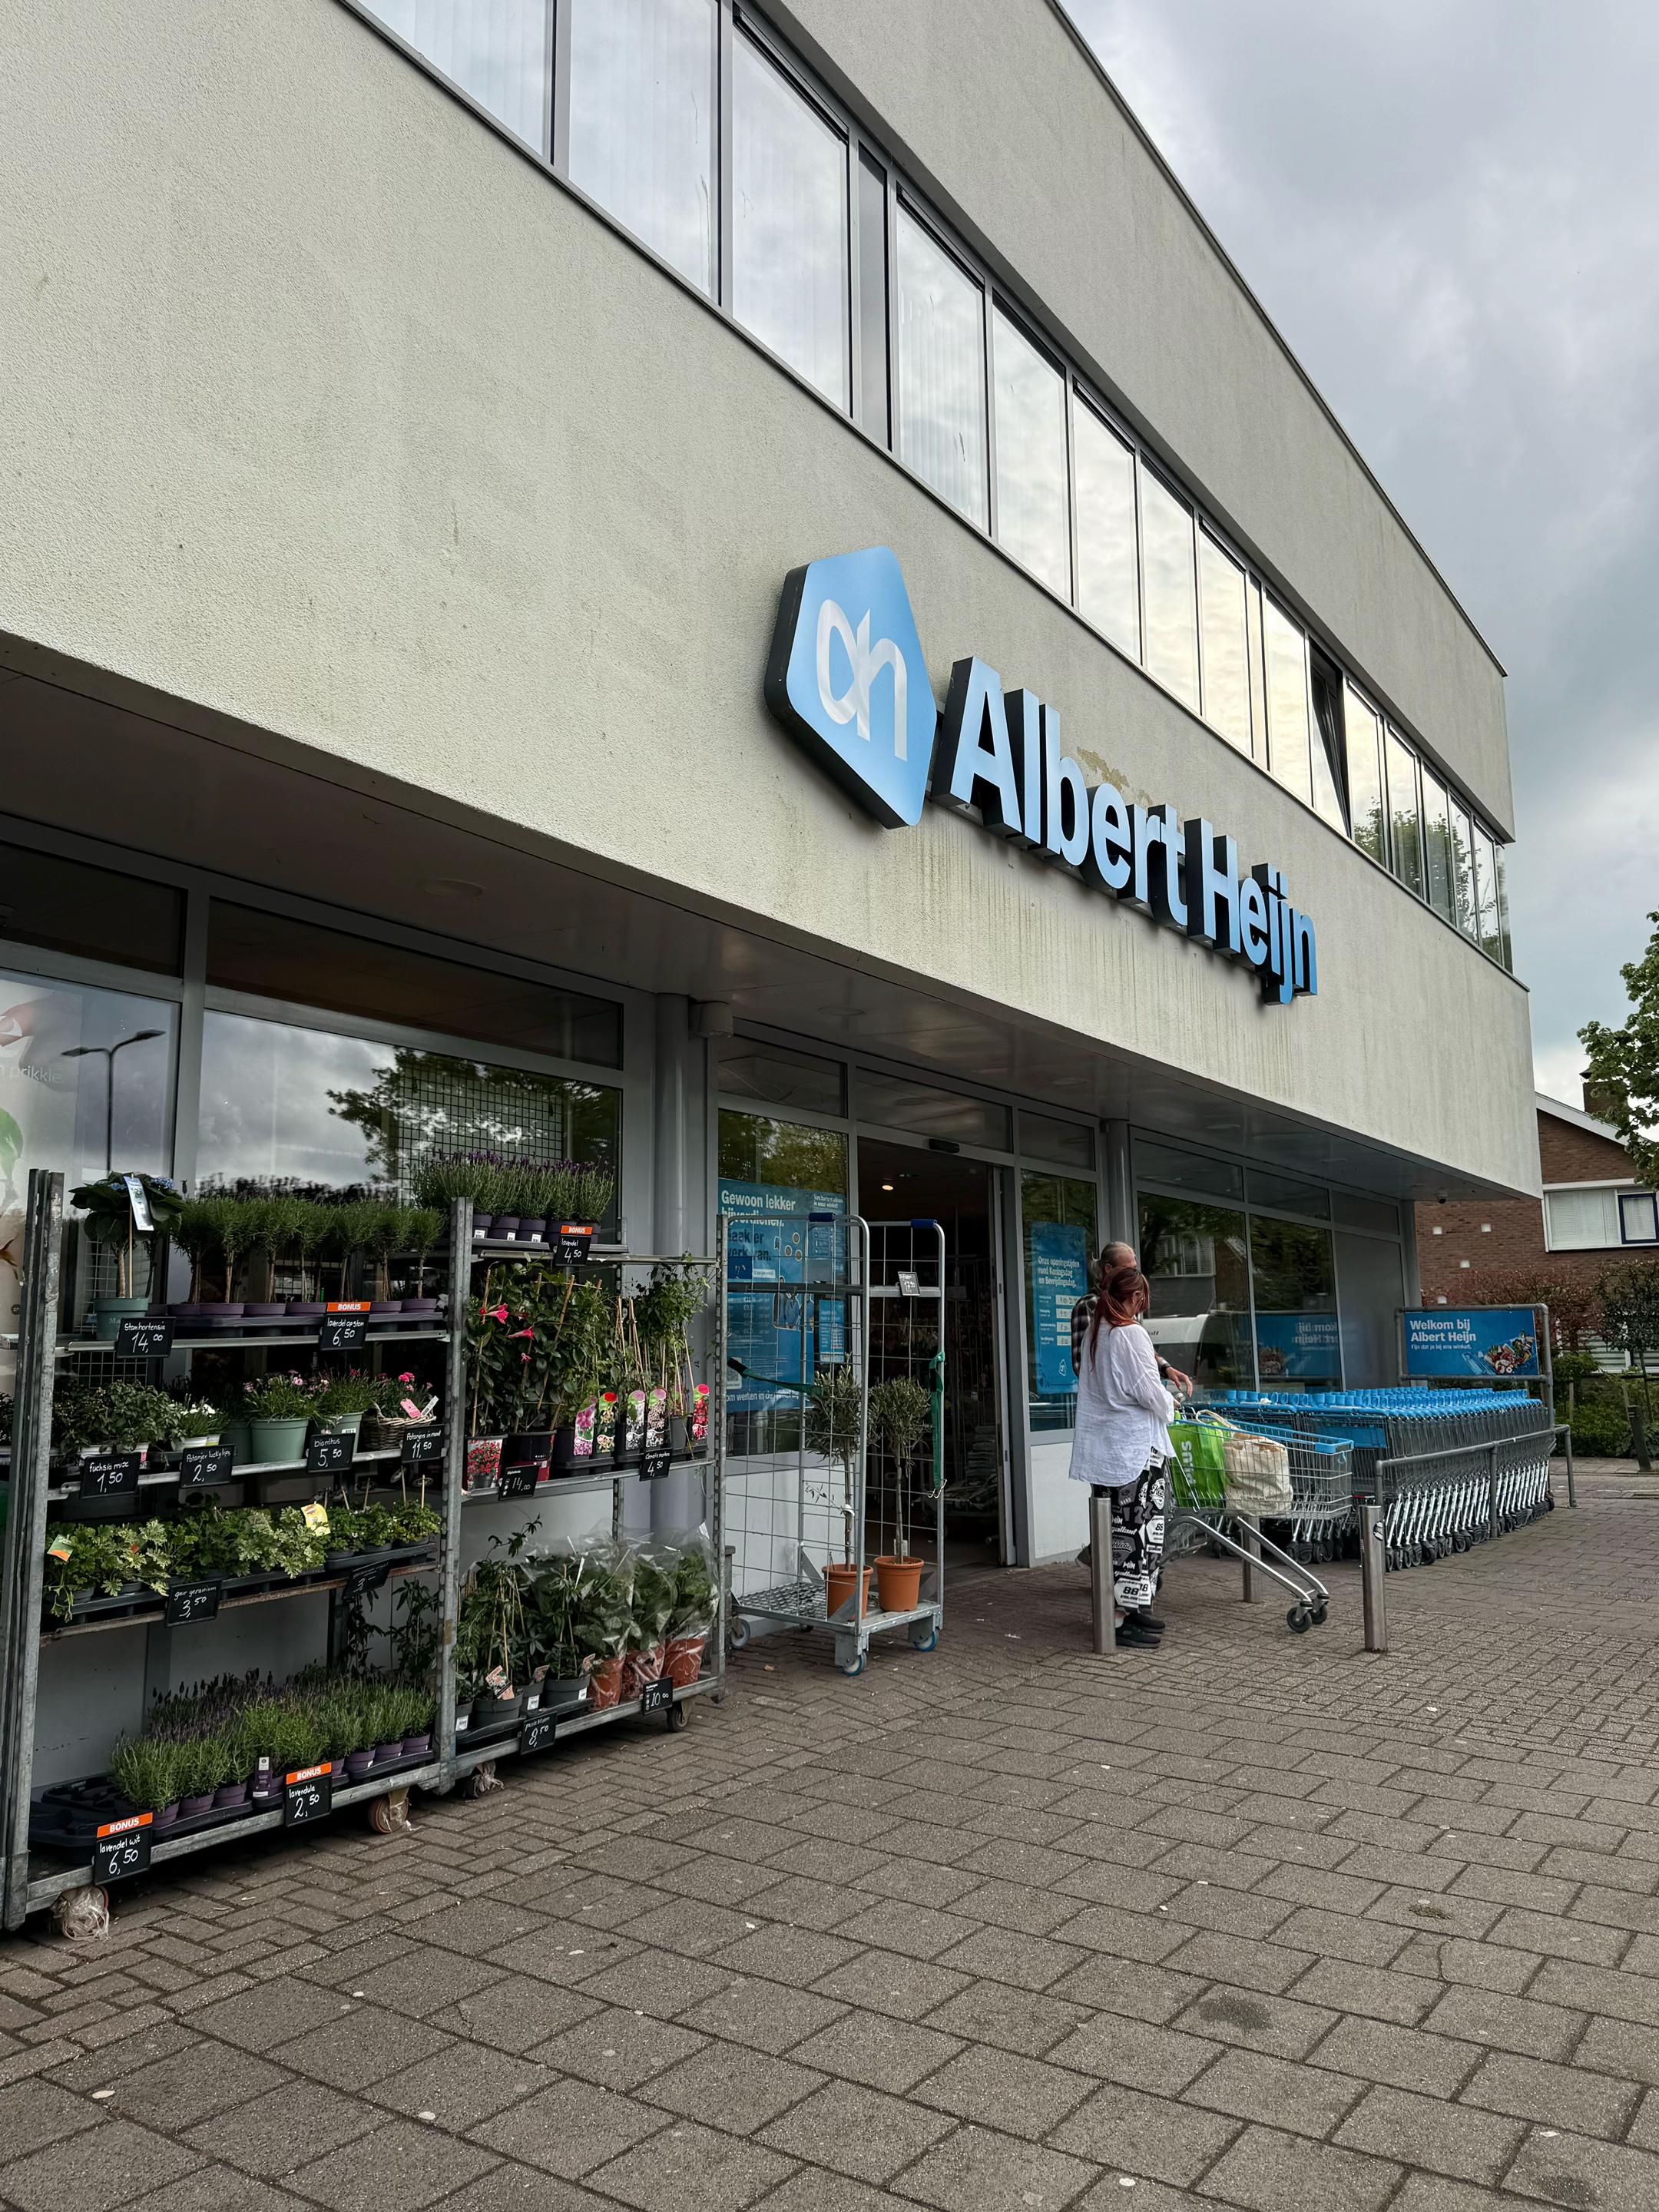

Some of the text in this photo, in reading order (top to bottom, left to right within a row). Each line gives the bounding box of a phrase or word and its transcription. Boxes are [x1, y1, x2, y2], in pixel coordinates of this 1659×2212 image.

[945, 655, 1318, 1005] Albert Heijn
[721, 1190, 796, 1211] Gewoon lekker
[728, 1230, 764, 1244] aak er
[1410, 1319, 1470, 1331] Welkom bij
[1410, 1331, 1476, 1343] Albert Heijn
[113, 1459, 129, 1471] mix
[296, 1767, 322, 1780] BONUS
[289, 1784, 316, 1799] lavendula
[109, 1818, 140, 1833] BONUS
[100, 1834, 141, 1853] lavendel wit
